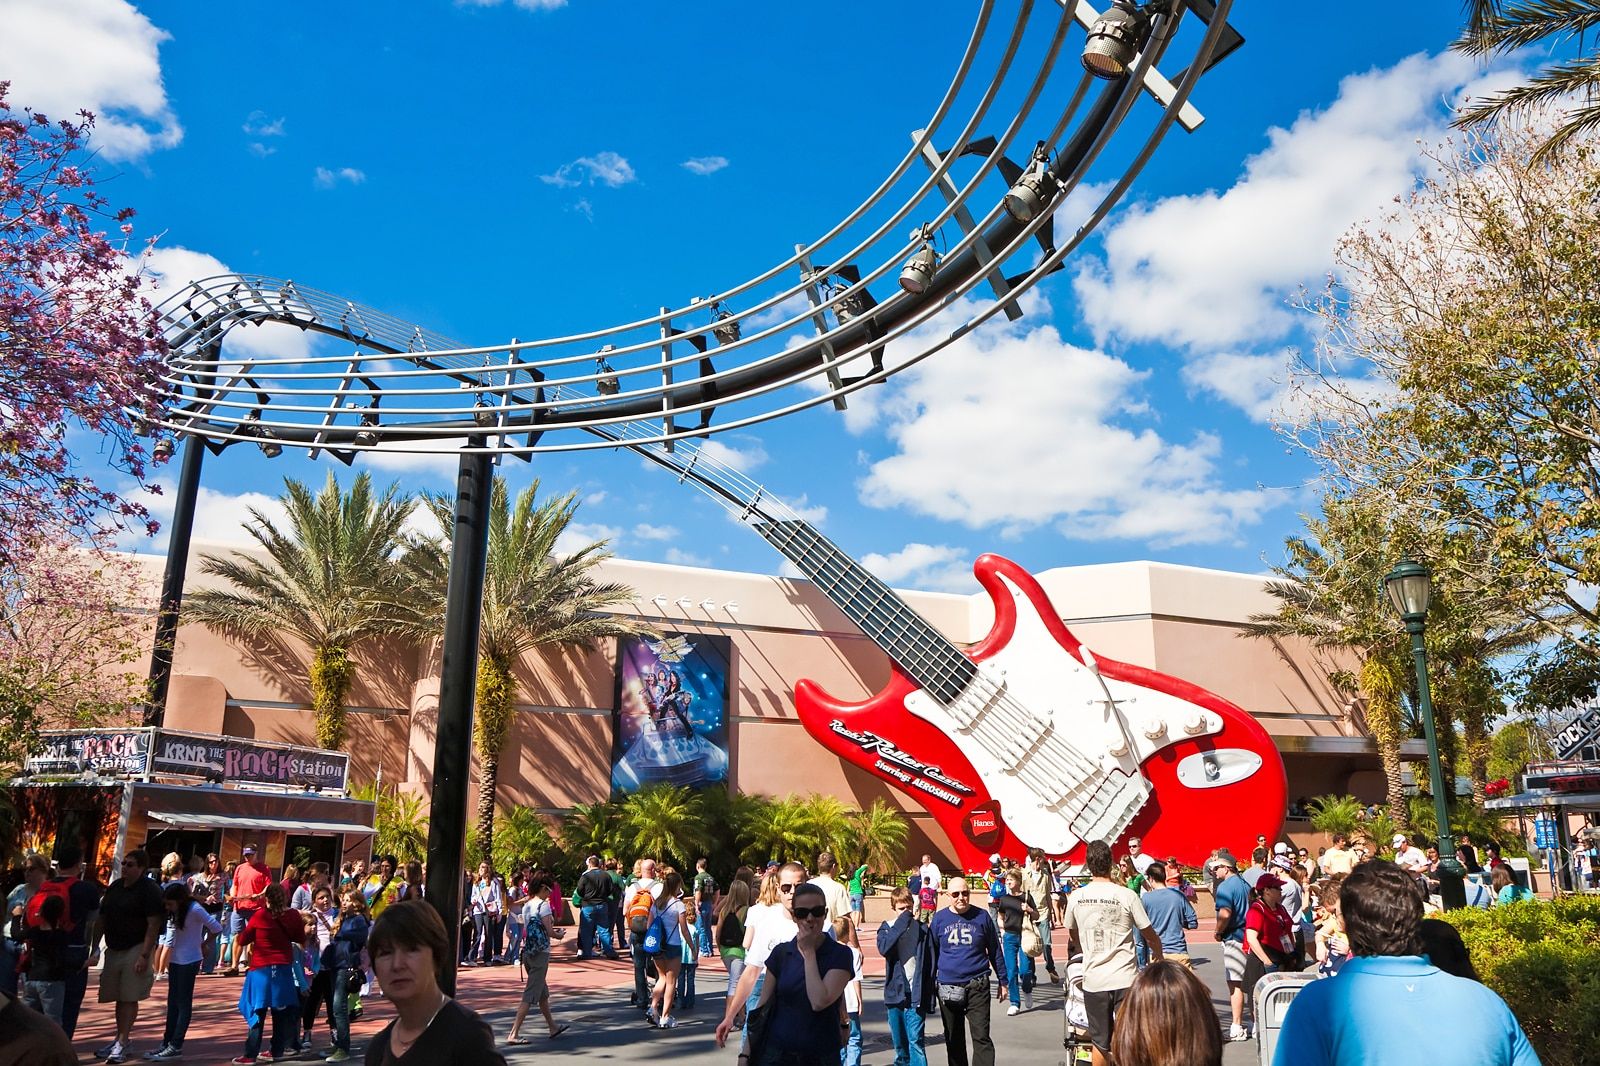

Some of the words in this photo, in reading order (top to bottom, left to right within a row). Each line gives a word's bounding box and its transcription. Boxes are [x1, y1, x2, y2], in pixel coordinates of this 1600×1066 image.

[83, 734, 138, 760] ROCK
[1553, 719, 1589, 755] ROCK
[91, 757, 140, 769] Station
[164, 742, 206, 763] KRNR
[209, 747, 225, 759] THE
[224, 748, 294, 779] ROCK
[290, 758, 342, 777] Station
[861, 730, 926, 771] Roller
[923, 766, 972, 793] Coaster
[911, 778, 961, 806] AEROSMITH
[973, 819, 995, 827] Hanes
[947, 927, 973, 945] 45
